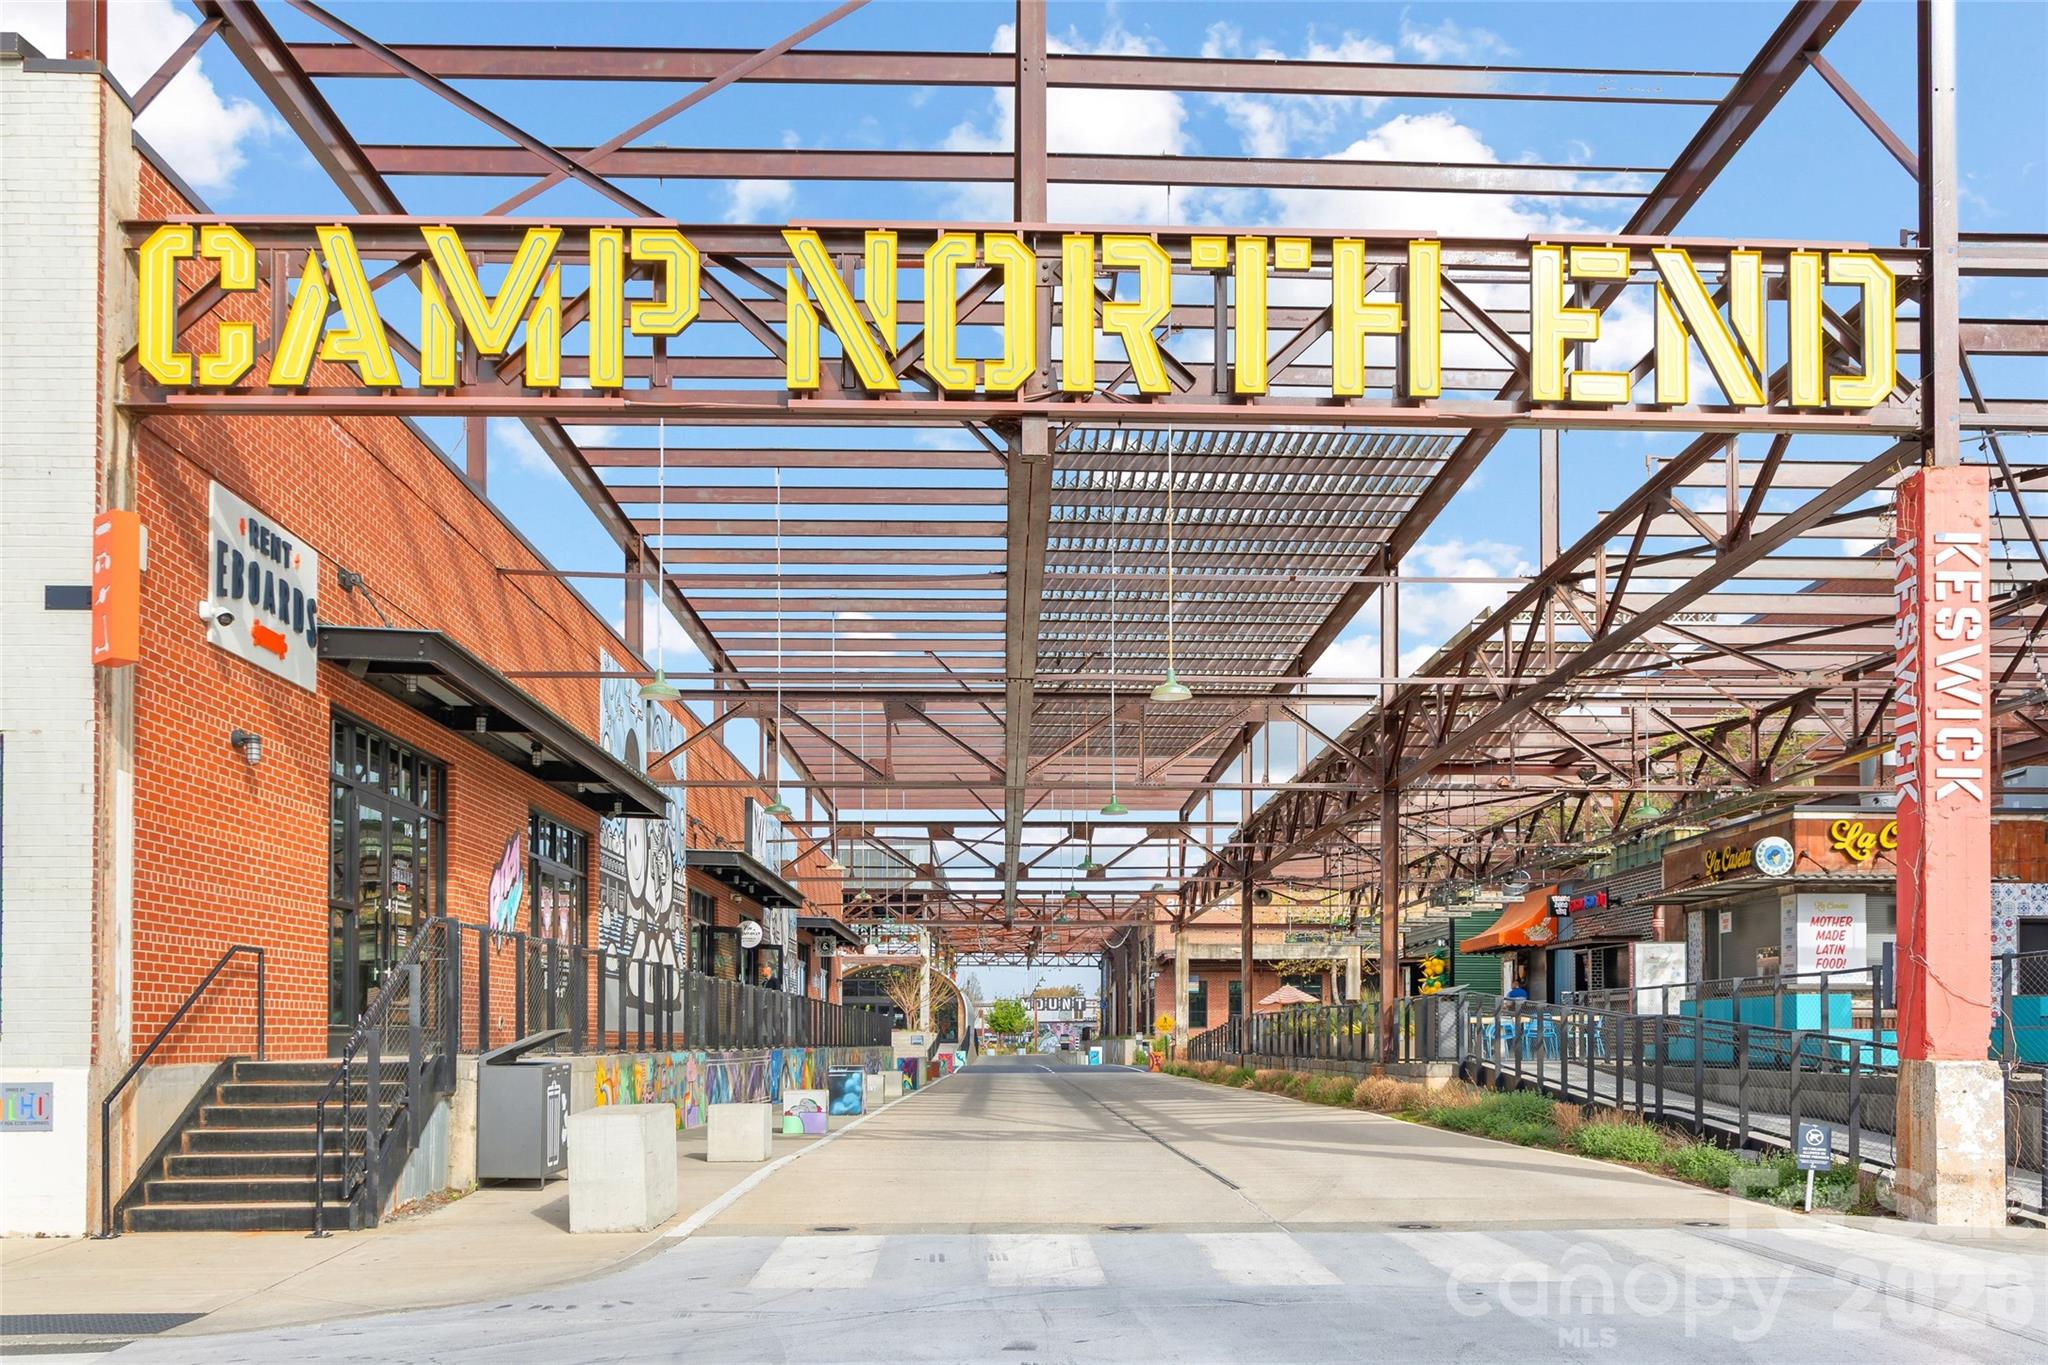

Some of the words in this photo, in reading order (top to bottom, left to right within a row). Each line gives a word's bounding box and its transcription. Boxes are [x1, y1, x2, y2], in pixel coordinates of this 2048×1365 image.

[138, 224, 700, 389] CAMP
[781, 230, 1442, 398] NORTH
[1530, 244, 1897, 409] END
[249, 517, 293, 570] RENT
[216, 539, 318, 649] EBOARDS
[1894, 537, 1918, 803] KESWICK
[1934, 532, 1984, 802] KESWICK
[1831, 820, 1877, 861] La
[1810, 915, 1853, 927] MOTHER
[1816, 930, 1847, 941] MADE
[1816, 945, 1846, 955] LATIN
[1816, 958, 1847, 969] FOOD!
